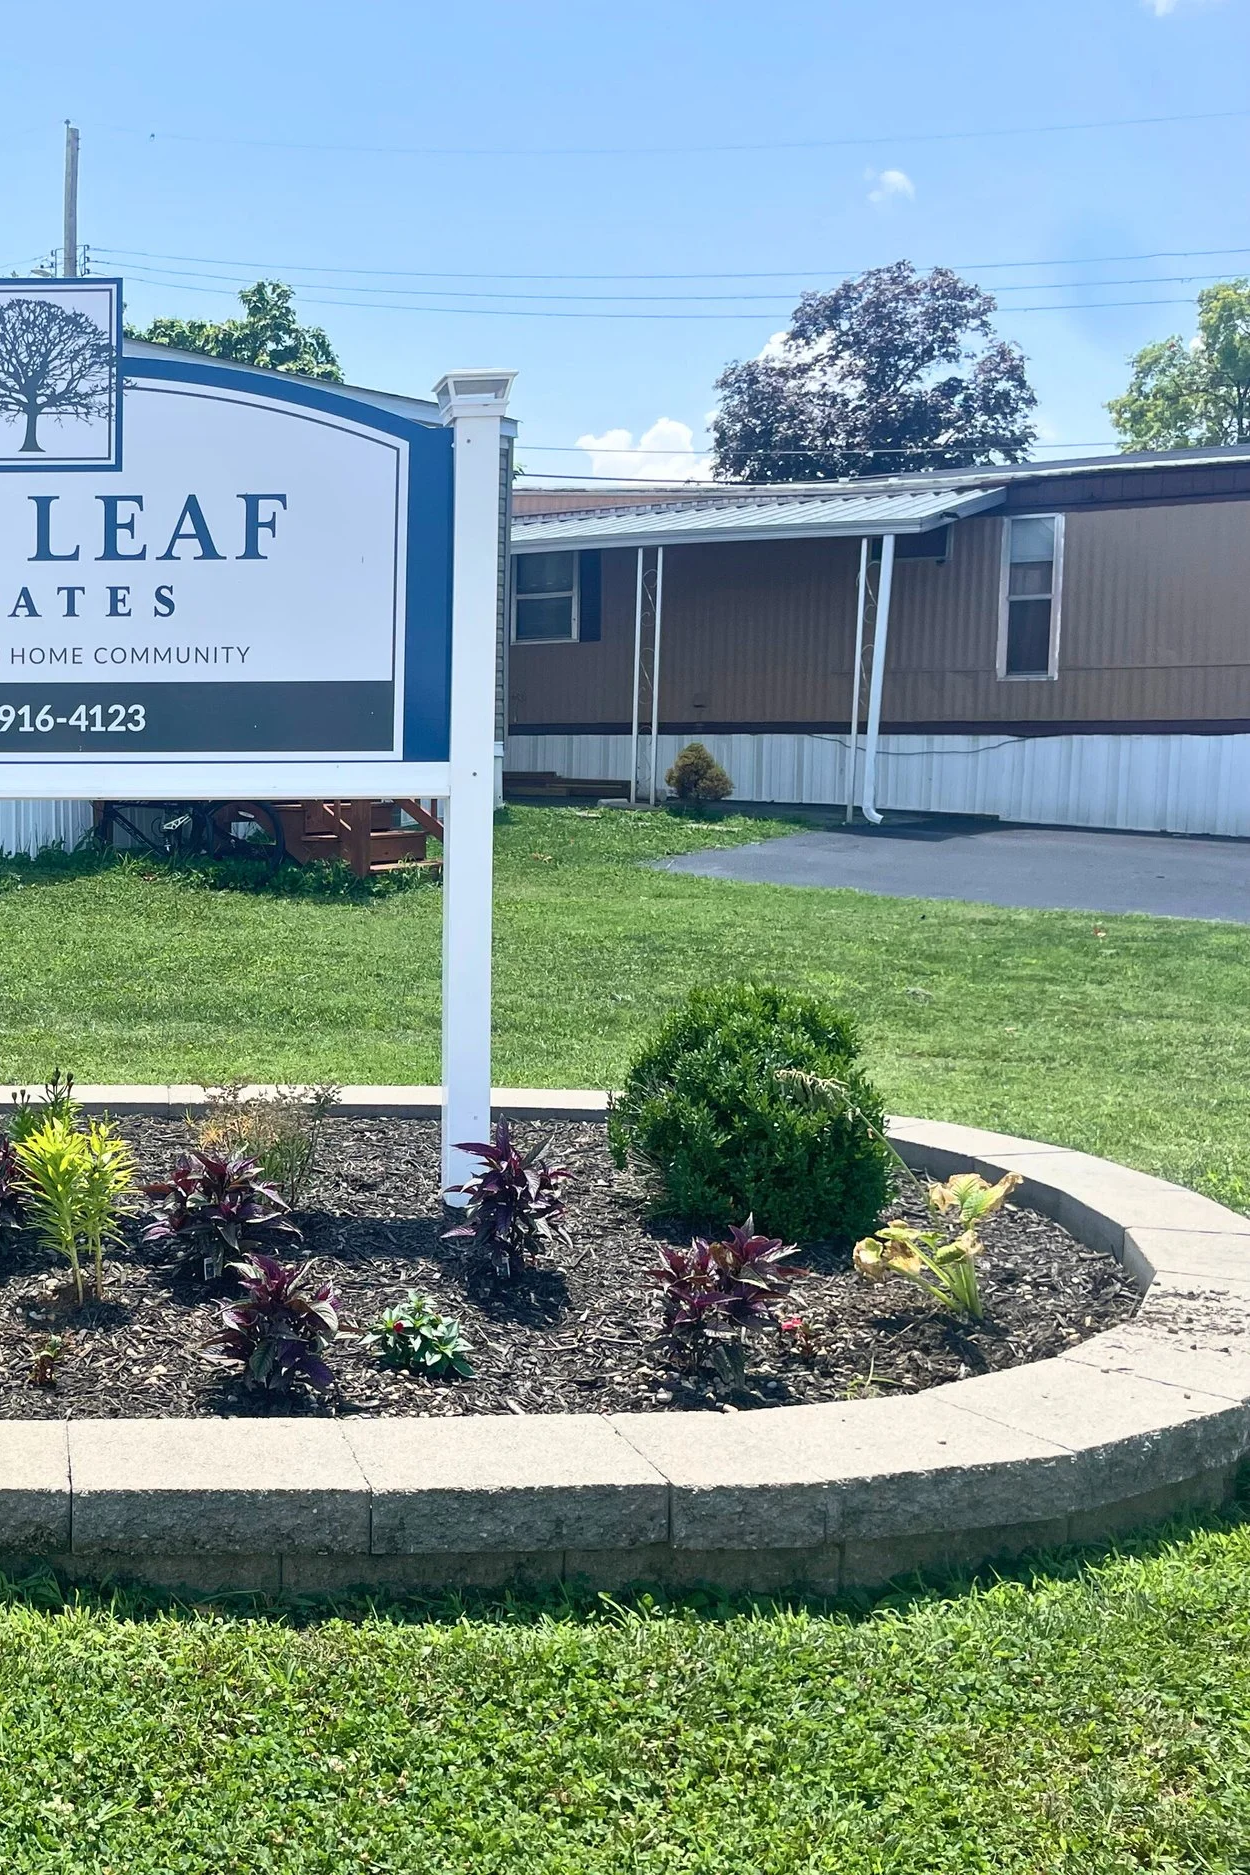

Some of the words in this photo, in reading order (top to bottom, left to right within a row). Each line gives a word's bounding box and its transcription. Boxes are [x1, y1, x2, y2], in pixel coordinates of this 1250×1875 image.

[27, 493, 288, 561] LEAF
[11, 647, 83, 665] HOME
[93, 646, 252, 665] COMMUNITY
